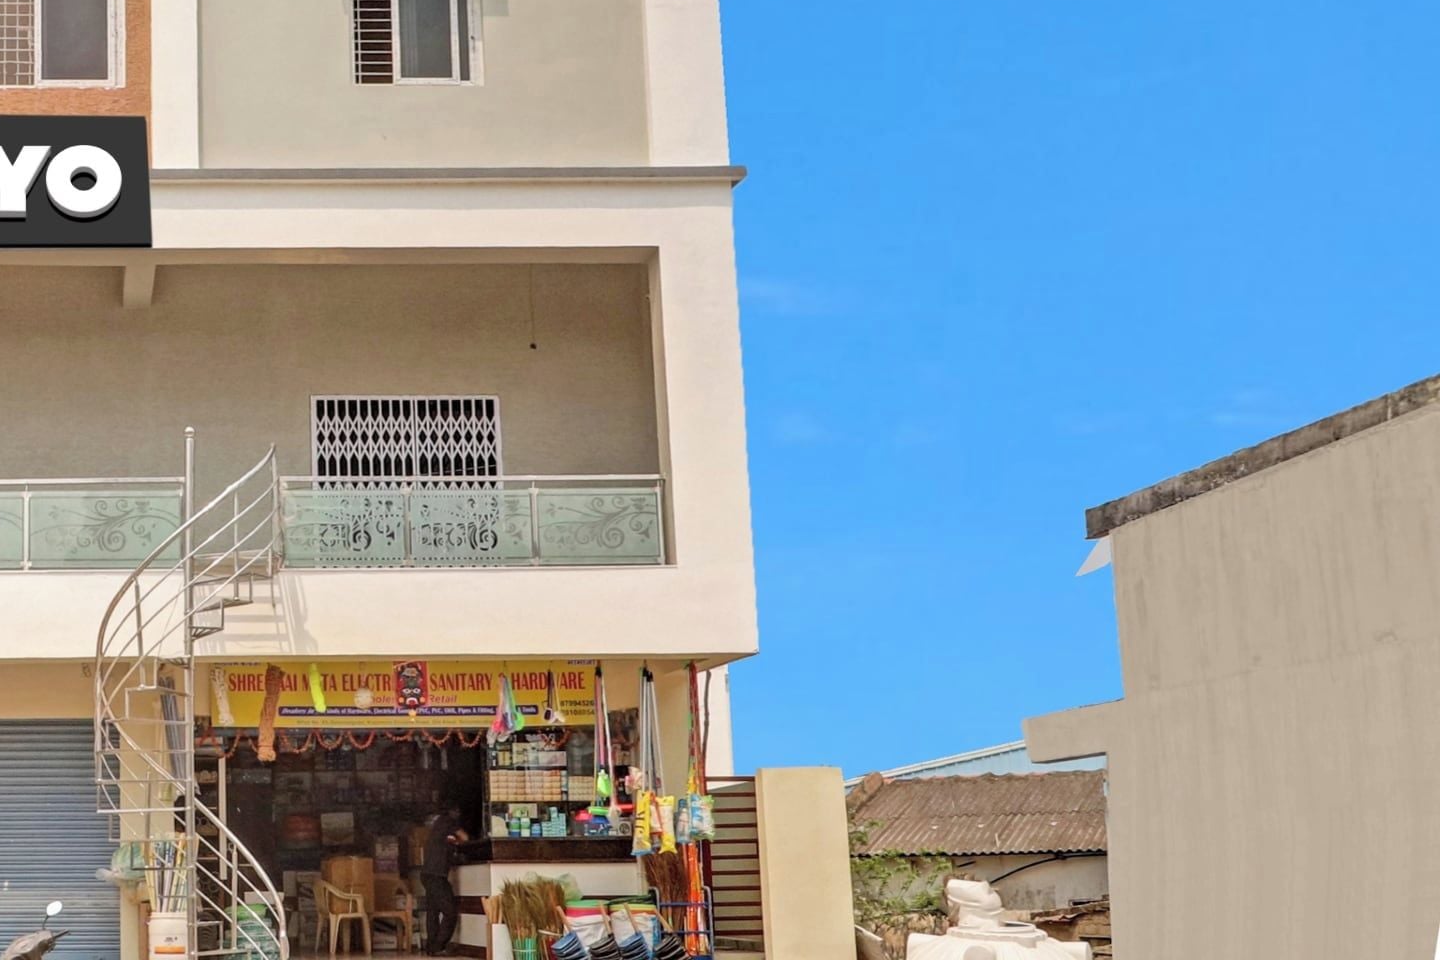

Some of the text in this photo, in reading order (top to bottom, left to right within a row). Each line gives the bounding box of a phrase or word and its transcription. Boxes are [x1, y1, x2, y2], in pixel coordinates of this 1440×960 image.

[228, 672, 269, 692] SHRE
[302, 672, 339, 692] MTA
[342, 672, 394, 692] ELCTR
[429, 671, 493, 692] SANITARY
[511, 671, 586, 691] HARDARE
